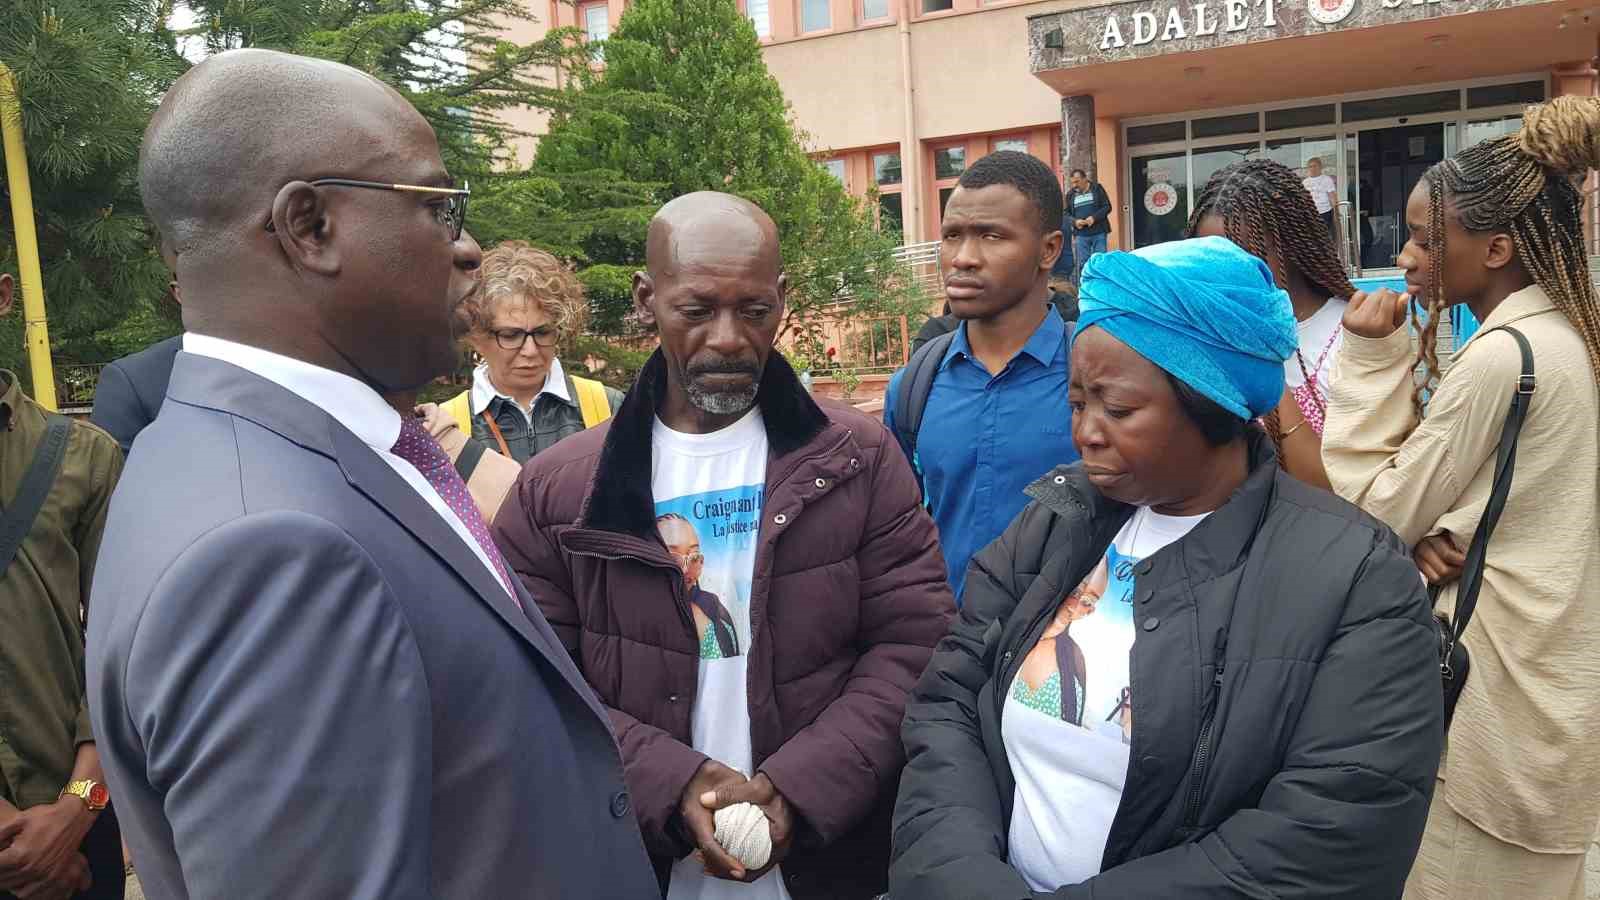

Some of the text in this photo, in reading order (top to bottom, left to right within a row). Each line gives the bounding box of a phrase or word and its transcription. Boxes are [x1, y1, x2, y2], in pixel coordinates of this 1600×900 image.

[1100, 0, 1281, 50] ADALET
[693, 496, 756, 521] Craignant
[712, 524, 725, 538] La
